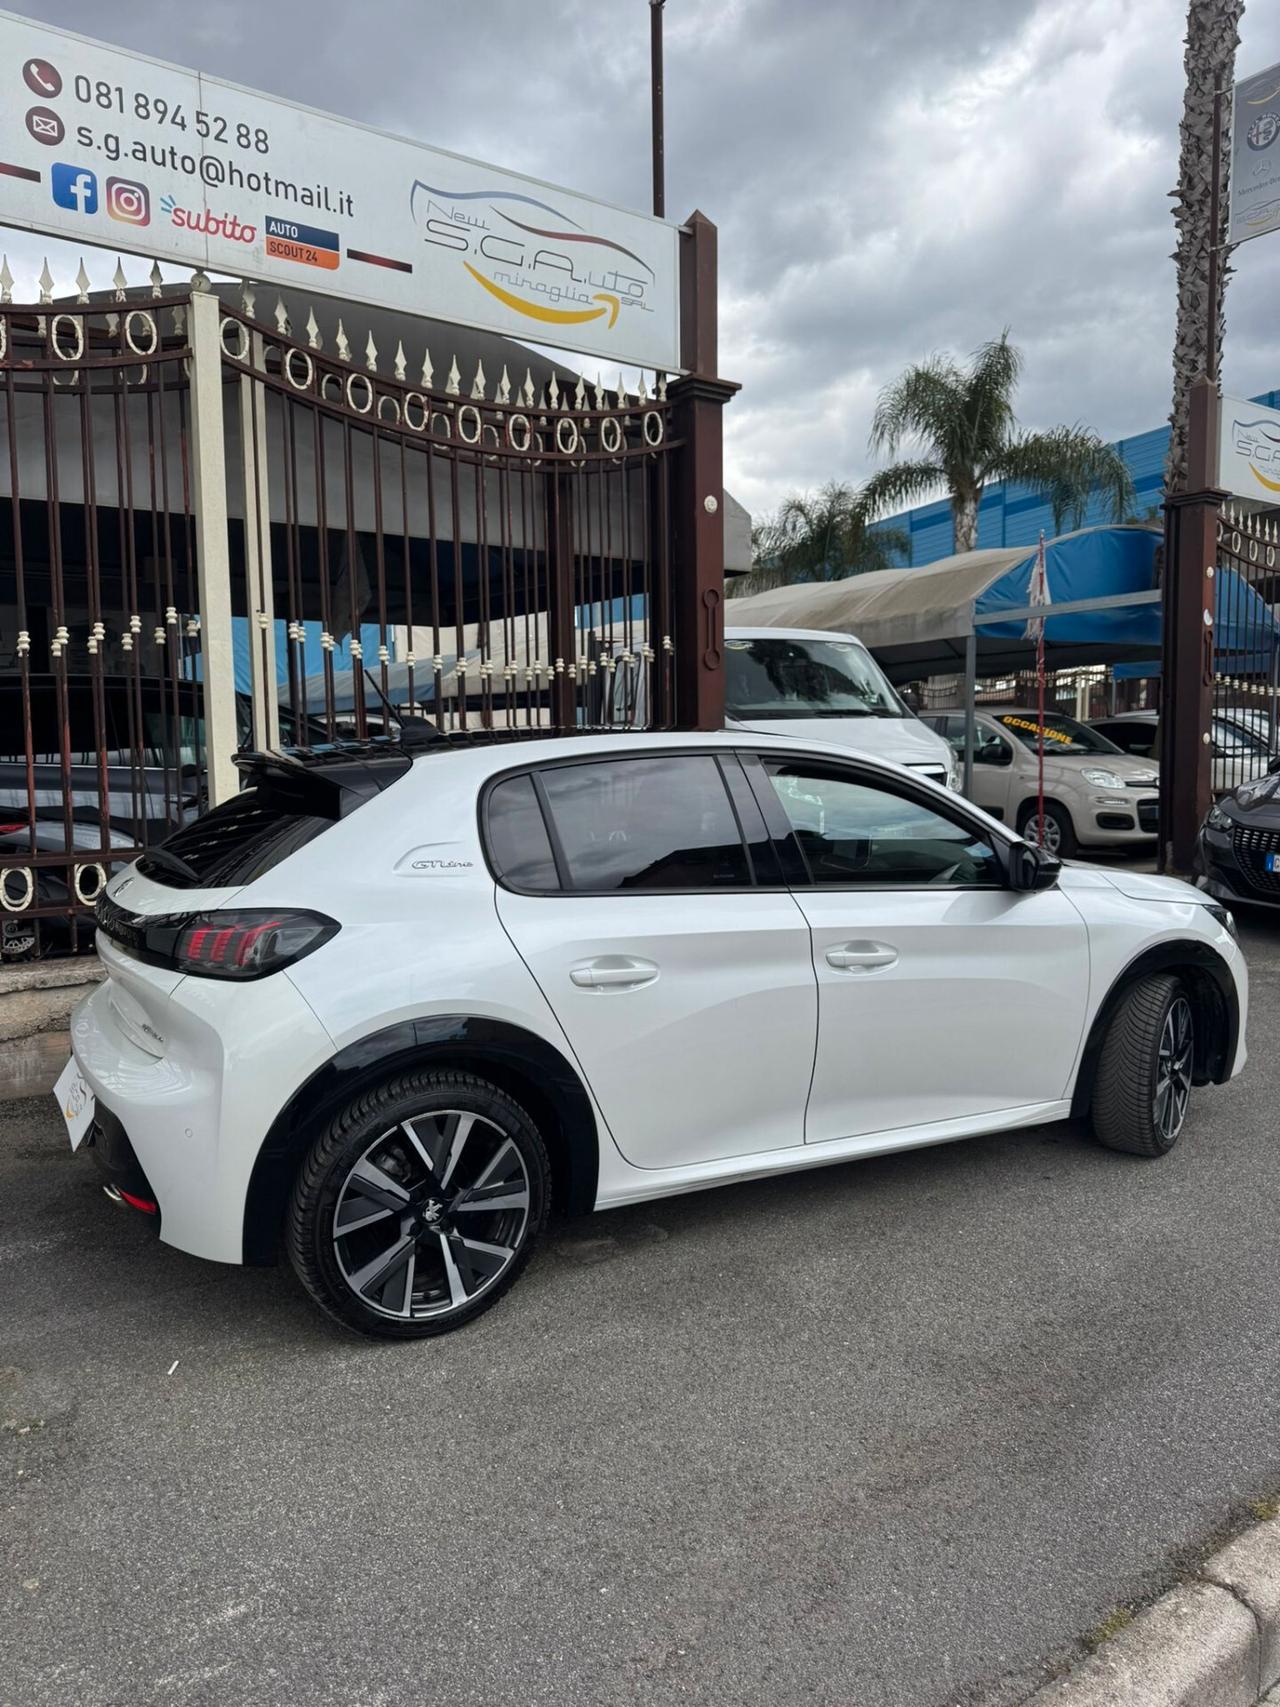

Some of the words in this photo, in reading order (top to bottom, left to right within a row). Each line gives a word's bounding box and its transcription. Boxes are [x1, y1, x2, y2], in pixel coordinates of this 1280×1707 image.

[75, 75, 125, 114] 081
[134, 93, 187, 131] 894
[196, 110, 228, 144] 52
[236, 123, 270, 154] 88
[77, 125, 354, 217] s.g.auto@hotmail.it
[172, 205, 257, 244] subito
[269, 221, 299, 239] AUTO
[427, 200, 490, 230] New
[270, 241, 304, 260] SCOUT
[306, 249, 318, 262] 24
[493, 271, 594, 303] miraglia
